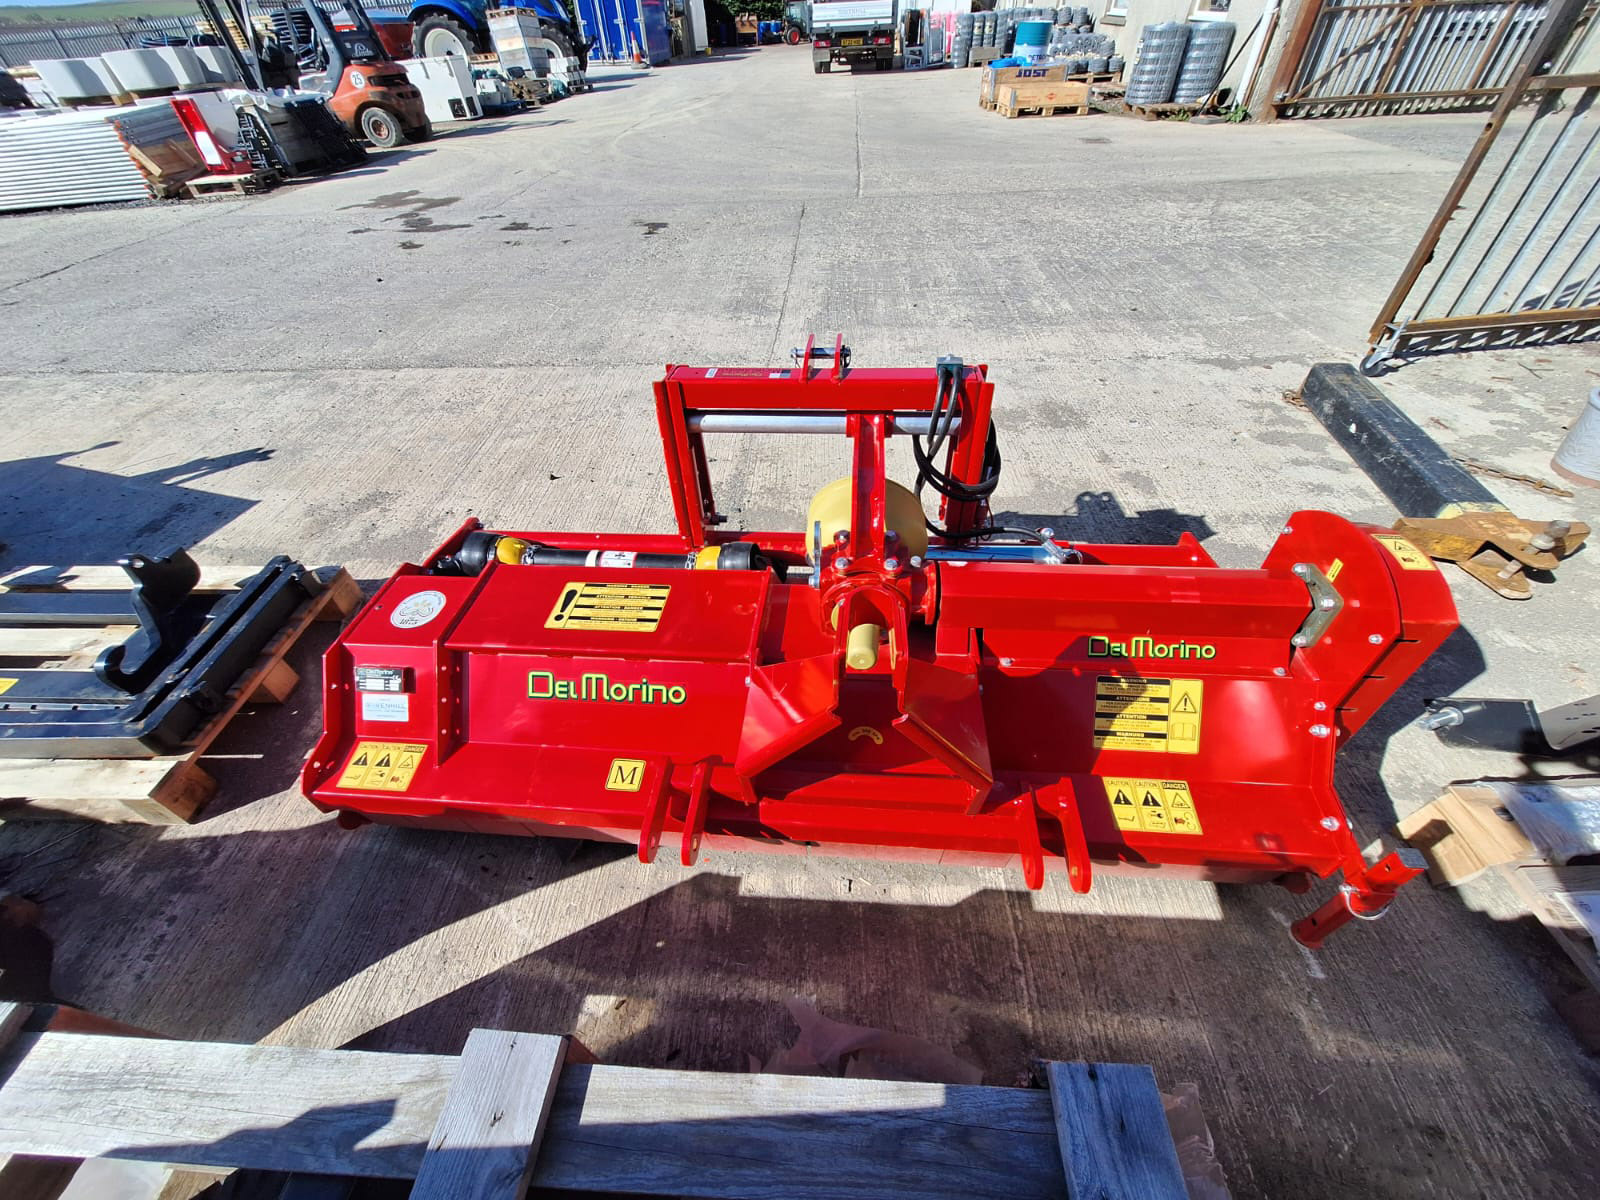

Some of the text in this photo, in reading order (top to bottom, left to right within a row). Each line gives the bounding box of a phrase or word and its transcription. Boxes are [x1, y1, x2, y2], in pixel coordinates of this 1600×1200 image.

[352, 73, 363, 86] 25
[1016, 68, 1049, 78] JOST
[612, 765, 639, 786] M
